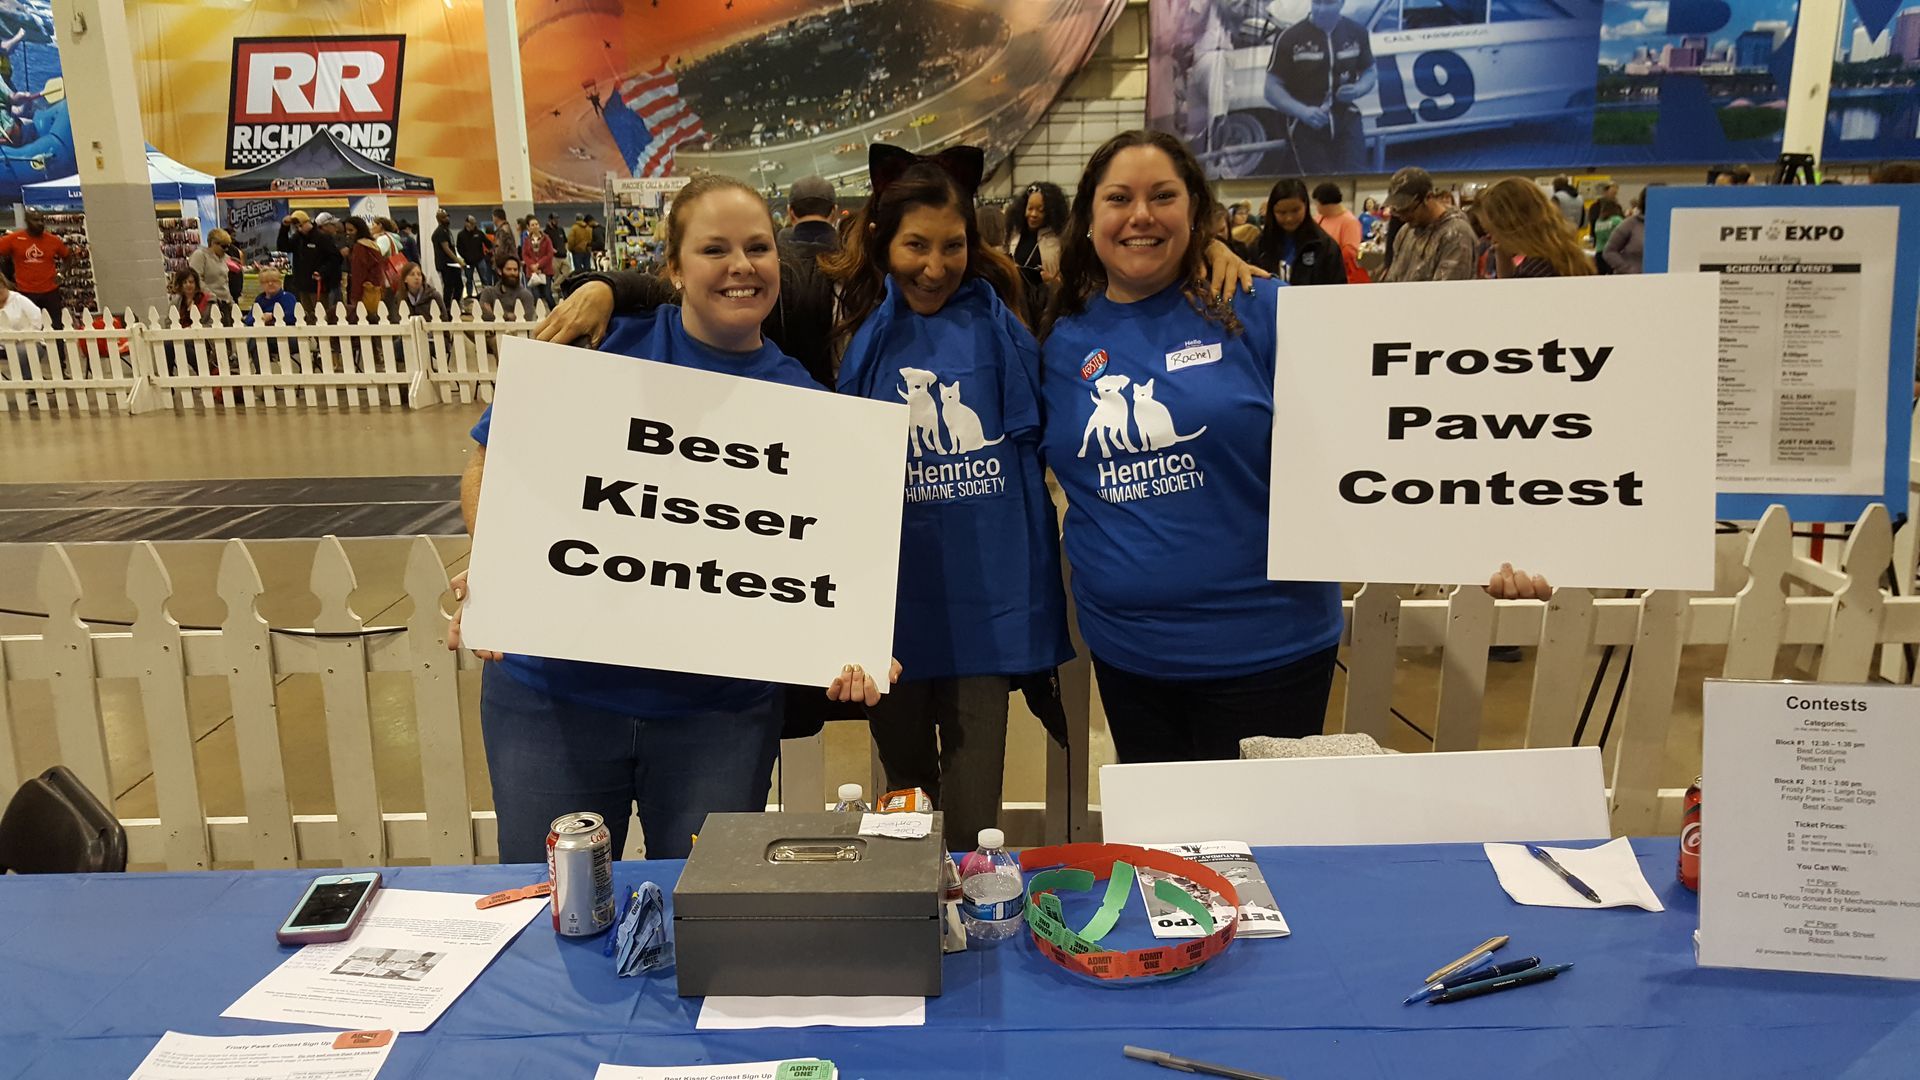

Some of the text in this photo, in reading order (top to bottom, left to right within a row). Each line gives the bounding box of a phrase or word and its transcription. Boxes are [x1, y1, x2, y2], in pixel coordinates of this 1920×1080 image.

[246, 50, 386, 114] RR
[1376, 50, 1475, 130] 19
[1720, 226, 1845, 241] PET EXPO
[1726, 264, 1834, 273] SCHEDULE OF EVENTS
[1170, 349, 1212, 366] Rachel
[1371, 338, 1615, 382] Frosty
[1388, 406, 1593, 440] Paws
[627, 417, 790, 475] Best
[907, 456, 1001, 486] Henrico
[1097, 452, 1196, 487] Henrico
[905, 477, 1006, 503] HUMANE SOCIETY
[1096, 470, 1205, 504] HUMANE SOCIETY
[1338, 469, 1643, 506] Contest
[582, 475, 818, 540] Kisser
[547, 539, 837, 608] Contest
[1786, 695, 1868, 712] Contests
[1804, 719, 1847, 728] Categories:
[1828, 756, 1846, 764] Eyes
[1781, 785, 1804, 794] Frosty
[1834, 788, 1855, 796] Large
[1856, 788, 1877, 797] Dogs
[1781, 793, 1804, 802] Frosty
[1805, 794, 1826, 802] Paws
[1856, 797, 1876, 805] Dogs
[1794, 820, 1847, 829] Ticket Prices:
[1813, 863, 1829, 871] Can
[1831, 864, 1849, 872] Win:
[1737, 890, 1750, 898] Gift
[1751, 891, 1770, 900] Card
[1779, 893, 1801, 901] Petco
[1802, 894, 1832, 903] donated
[1833, 896, 1842, 904] by
[1800, 886, 1825, 895] Trophy
[1834, 888, 1861, 896] Ribbon
[1801, 902, 1828, 911] Picture
[1839, 905, 1876, 914] Facebook
[1239, 913, 1281, 922] PET
[1784, 926, 1797, 934] Gift
[1798, 927, 1814, 936] Bag
[1814, 928, 1832, 936] from
[1852, 930, 1875, 939] Street
[1808, 936, 1835, 945] Ribbon
[1185, 941, 1205, 954] ADMIT
[1088, 956, 1112, 965] ADMIT
[1139, 951, 1163, 962] ADMIT
[1189, 950, 1203, 960] ONE
[1092, 965, 1109, 974] ONE
[1143, 960, 1160, 970] ONE
